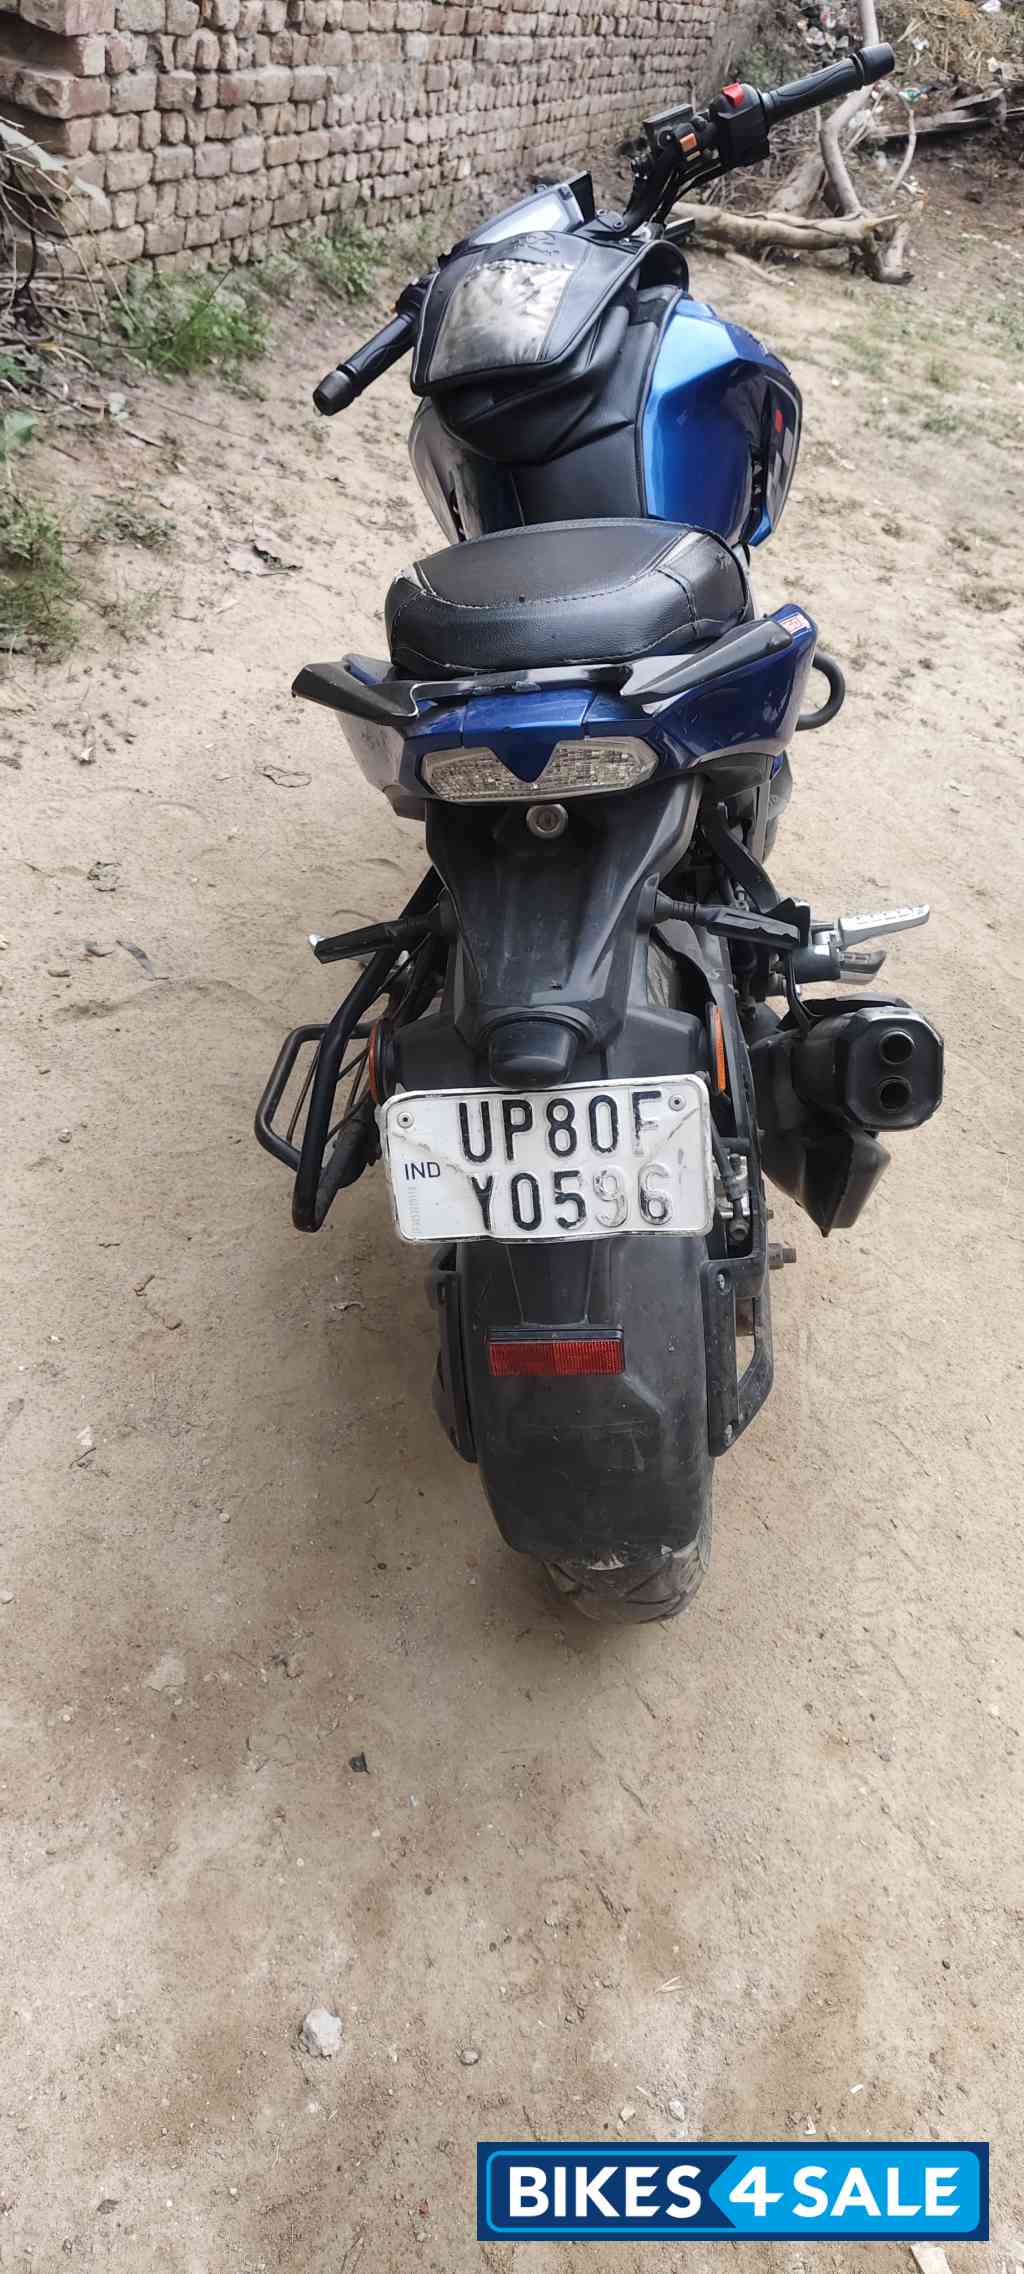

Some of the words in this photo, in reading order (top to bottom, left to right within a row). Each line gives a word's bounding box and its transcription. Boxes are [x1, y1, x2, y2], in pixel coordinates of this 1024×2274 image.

[459, 1090, 662, 1163] UP80F
[404, 1161, 441, 1180] IND
[471, 1162, 673, 1232] Y0596
